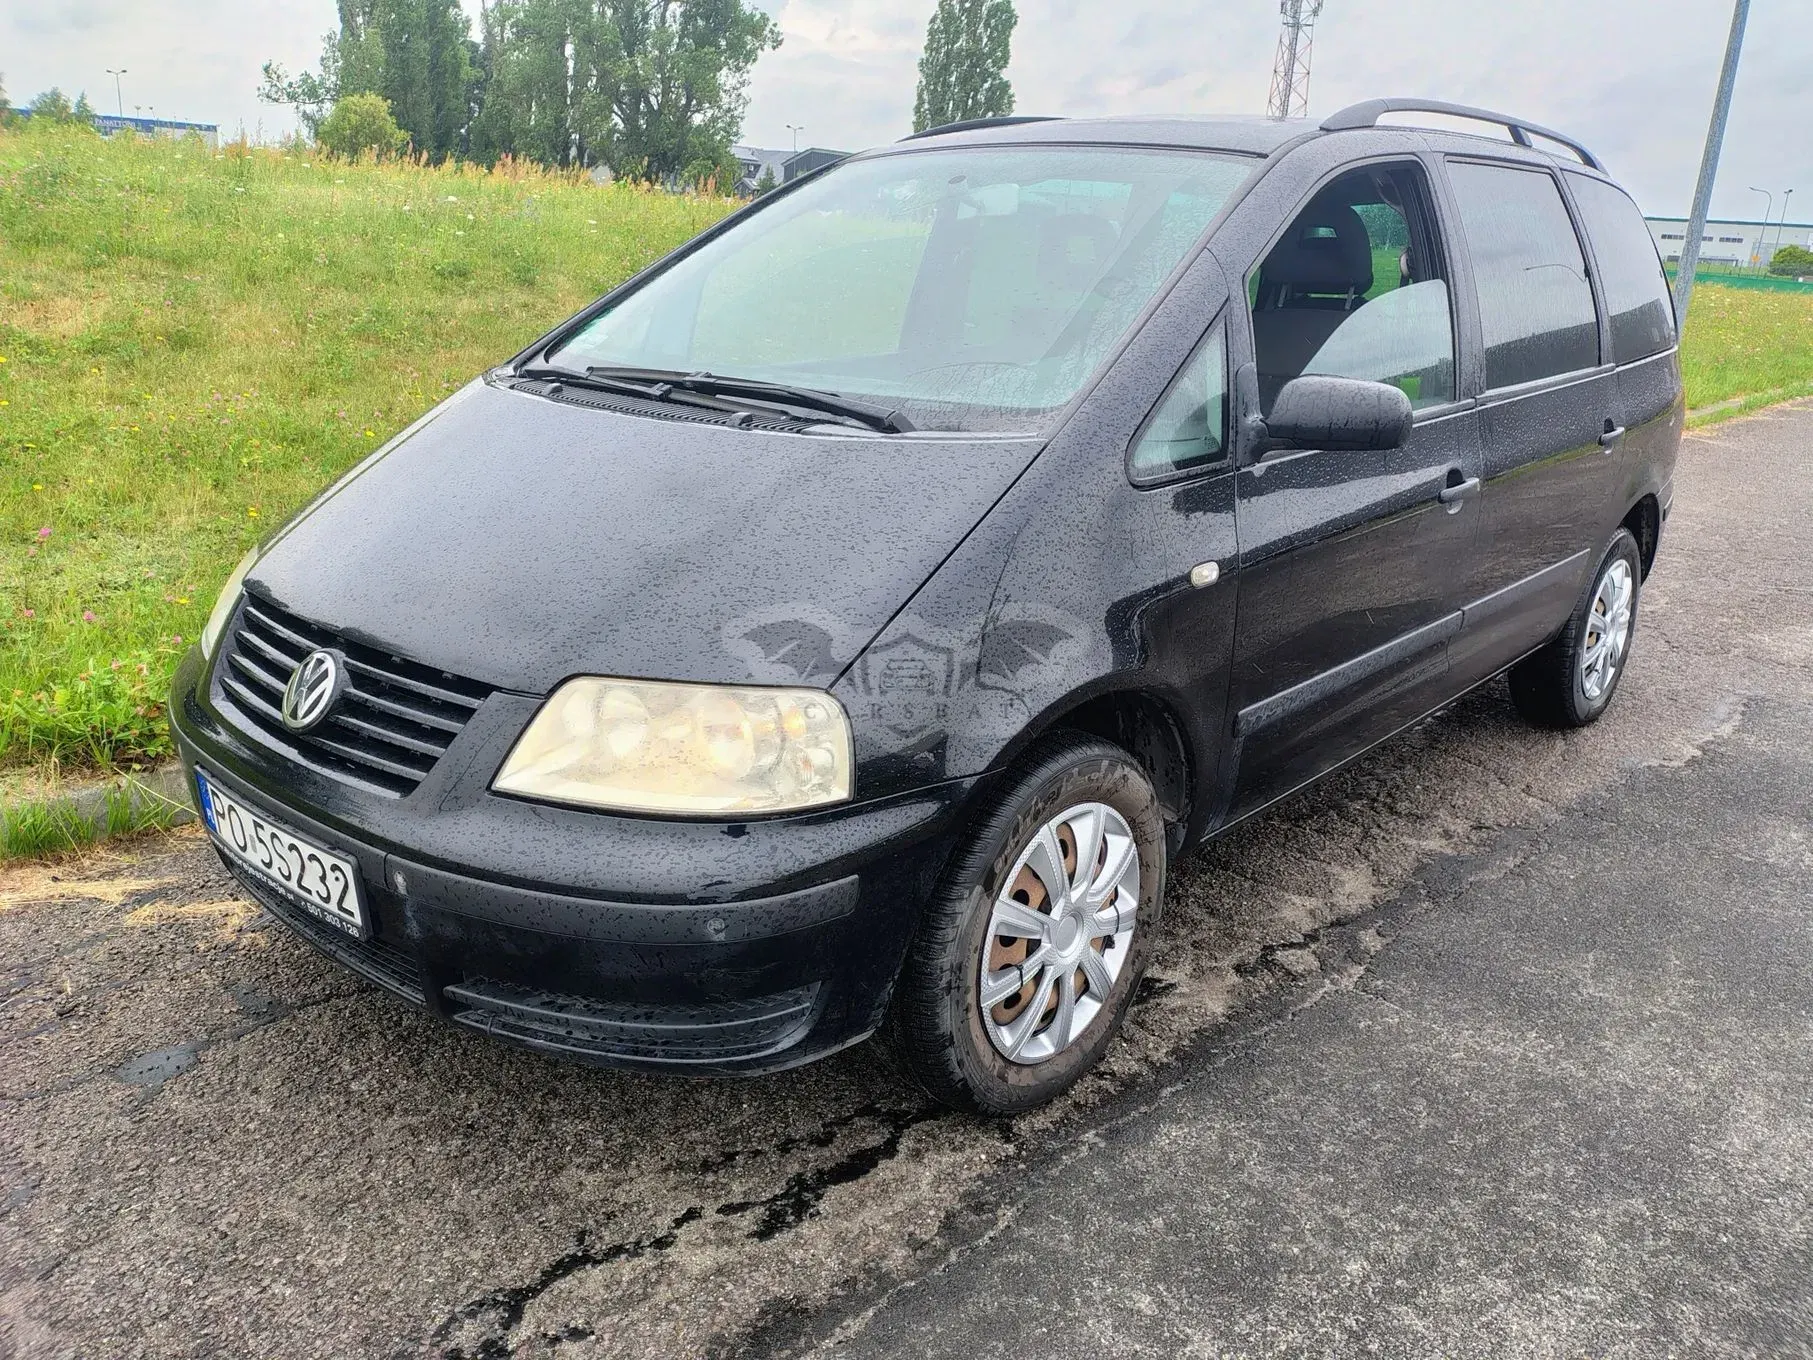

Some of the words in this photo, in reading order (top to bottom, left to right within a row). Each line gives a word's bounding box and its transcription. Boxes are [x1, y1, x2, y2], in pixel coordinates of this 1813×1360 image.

[210, 788, 247, 853] PO
[252, 819, 355, 918] 5S232
[306, 901, 322, 918] 501
[324, 911, 341, 928] 303
[342, 921, 360, 938] 128
